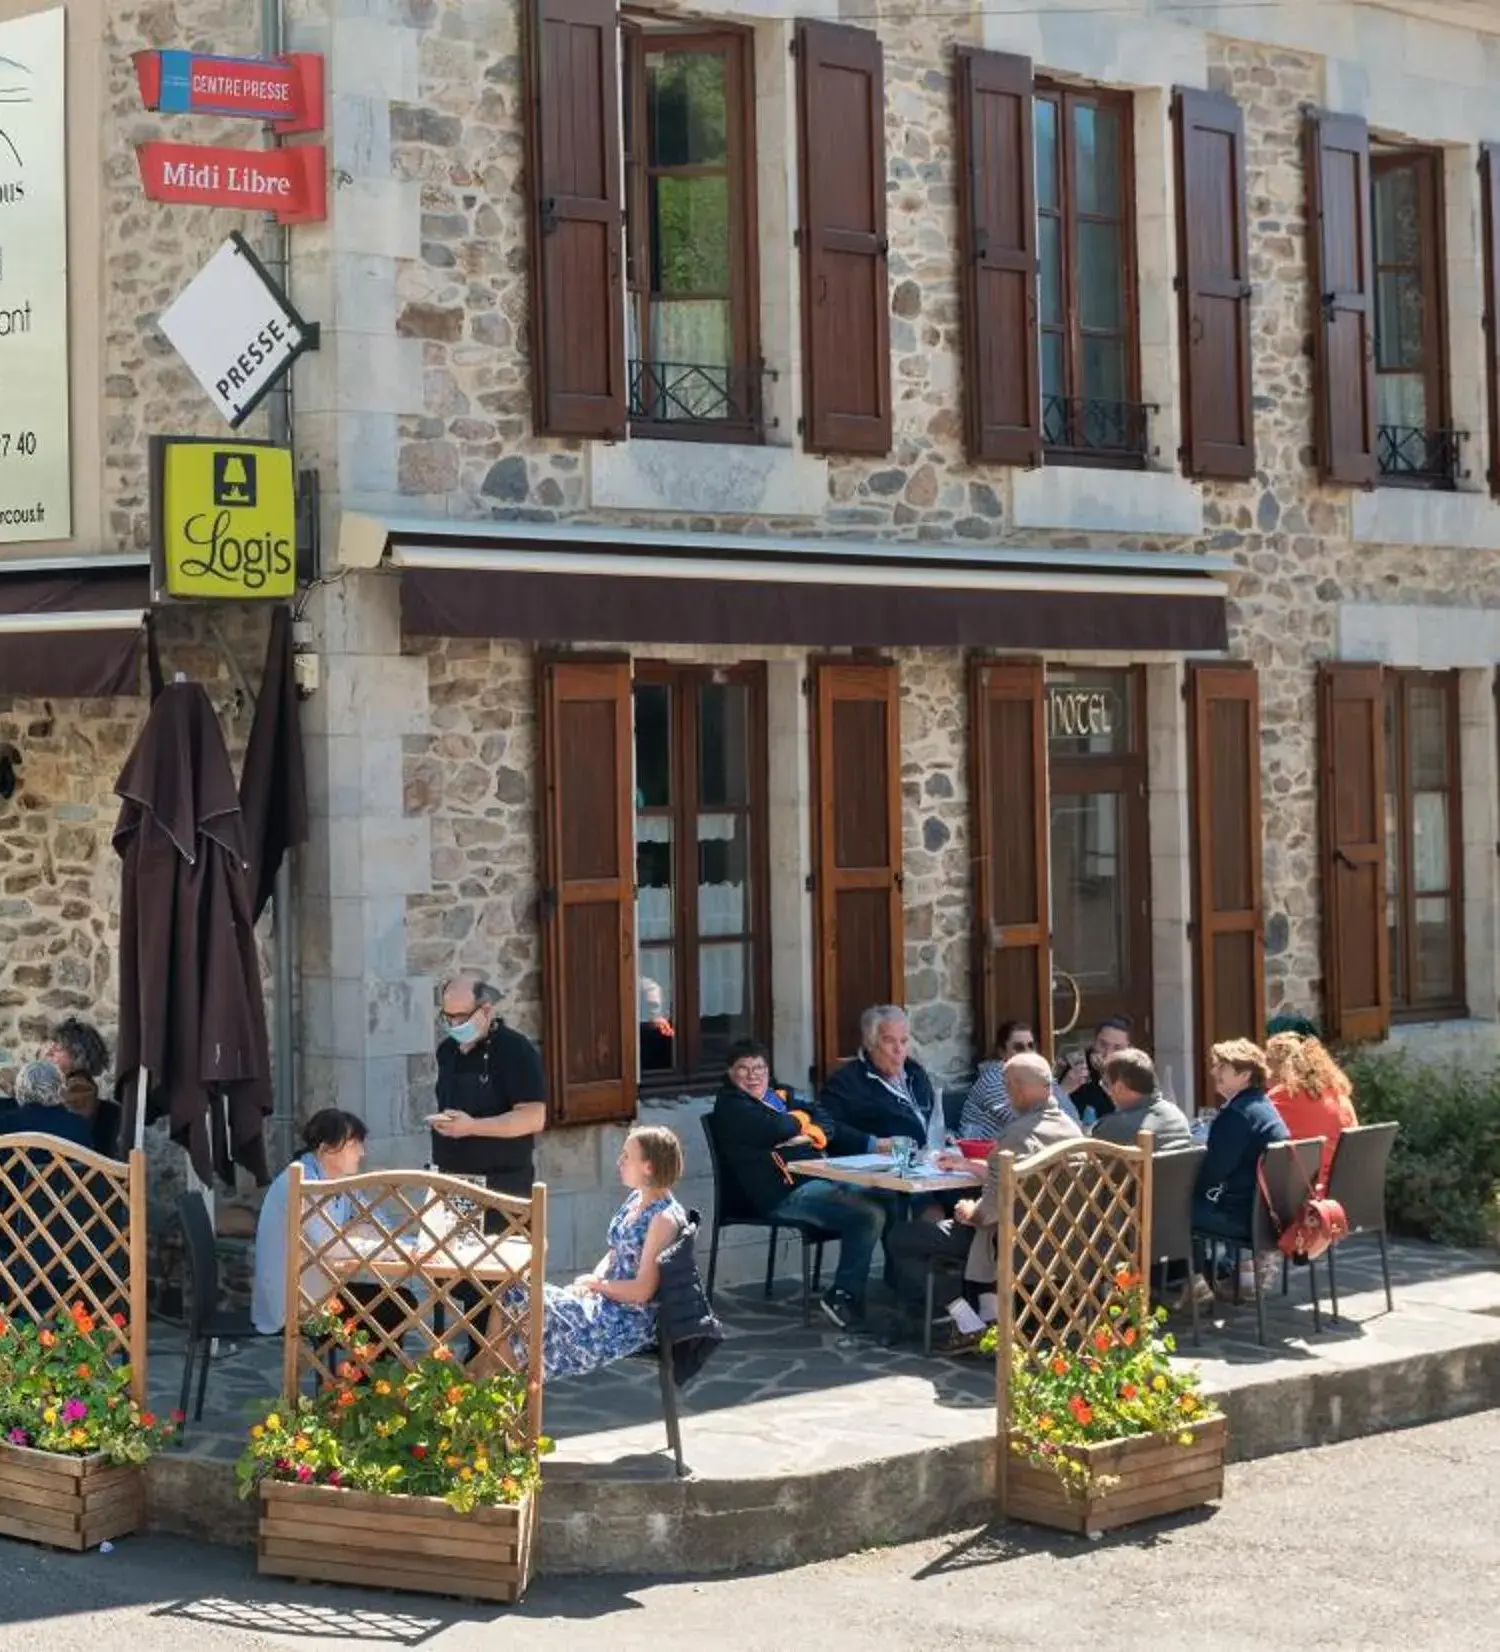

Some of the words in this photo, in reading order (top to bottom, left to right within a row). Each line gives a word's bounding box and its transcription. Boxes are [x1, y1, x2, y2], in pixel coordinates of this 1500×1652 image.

[193, 75, 241, 97] CENTRE
[243, 80, 290, 101] PRESSE
[163, 162, 219, 188] Midi
[227, 167, 290, 196] Libre
[215, 319, 285, 401] PRESSE
[16, 431, 37, 456] 40
[180, 509, 291, 588] Logis
